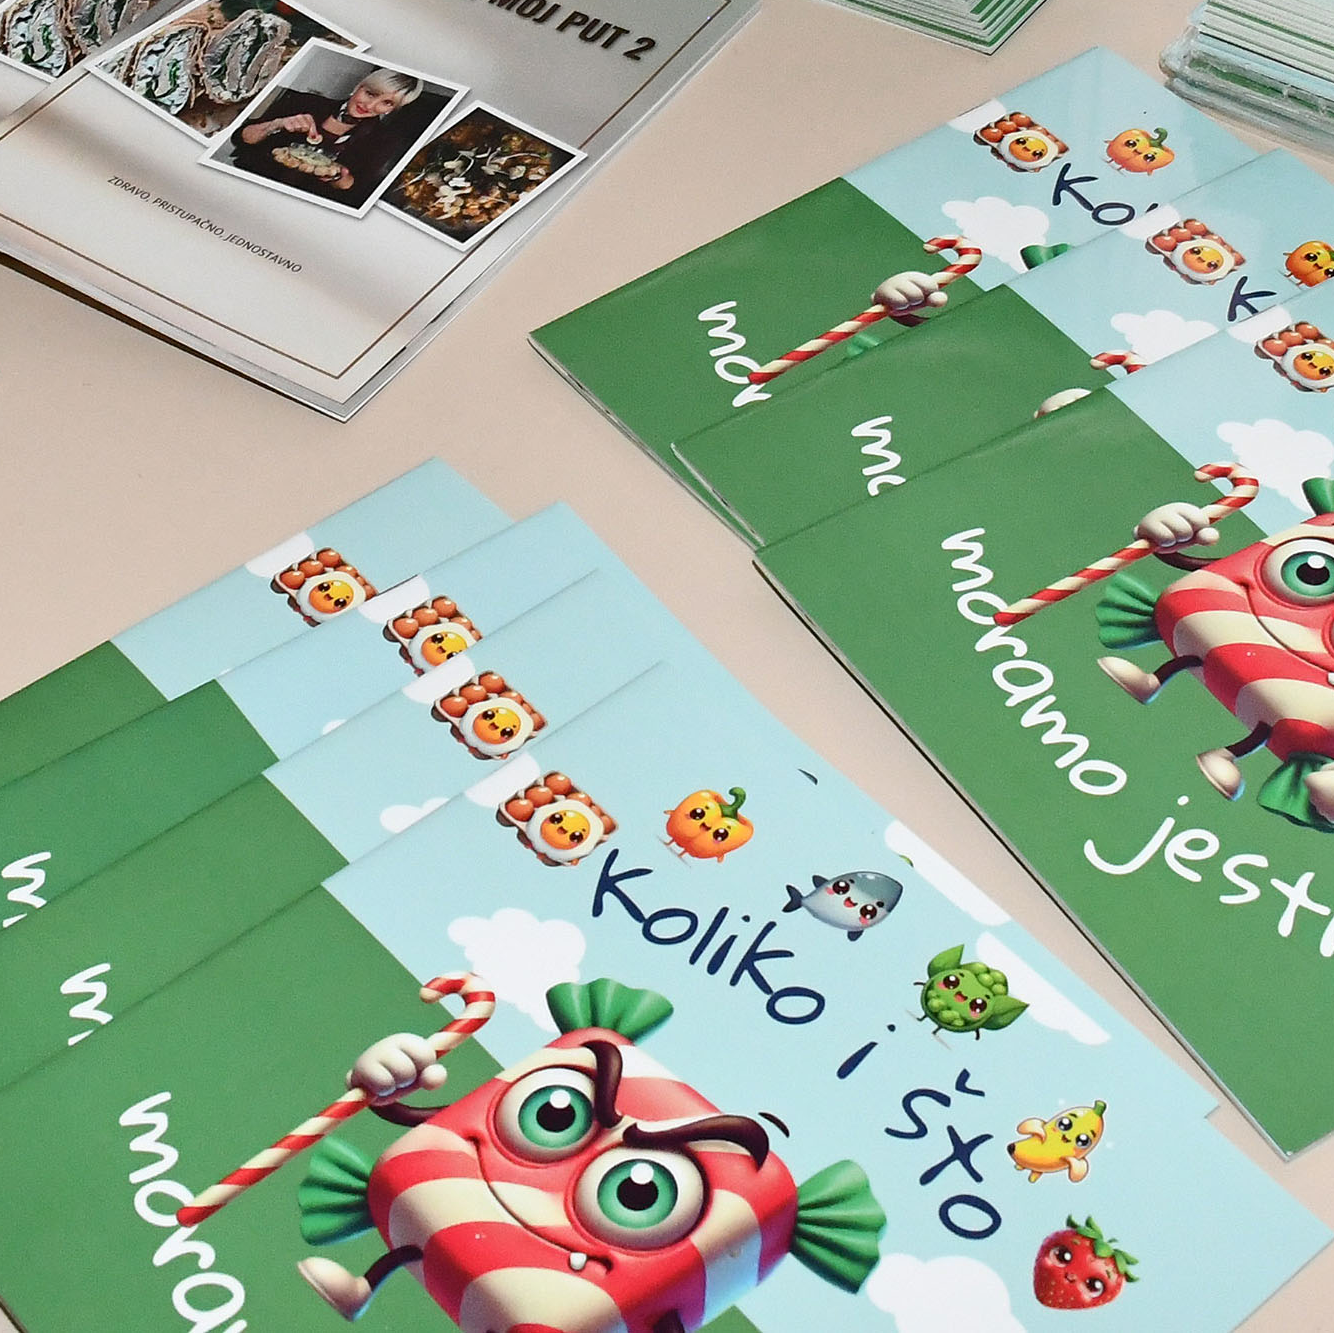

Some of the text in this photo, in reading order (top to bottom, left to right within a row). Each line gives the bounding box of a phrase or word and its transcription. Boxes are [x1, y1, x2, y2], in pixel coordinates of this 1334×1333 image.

[556, 10, 630, 50] PUT
[623, 36, 657, 62] 2
[107, 176, 303, 273] ZDRAVO, PRISTUPAČNO, JEDNOSTAVNO
[939, 526, 1127, 798] moramo
[591, 848, 1003, 1241] Koliko i Što
[119, 1091, 248, 1333] mora
